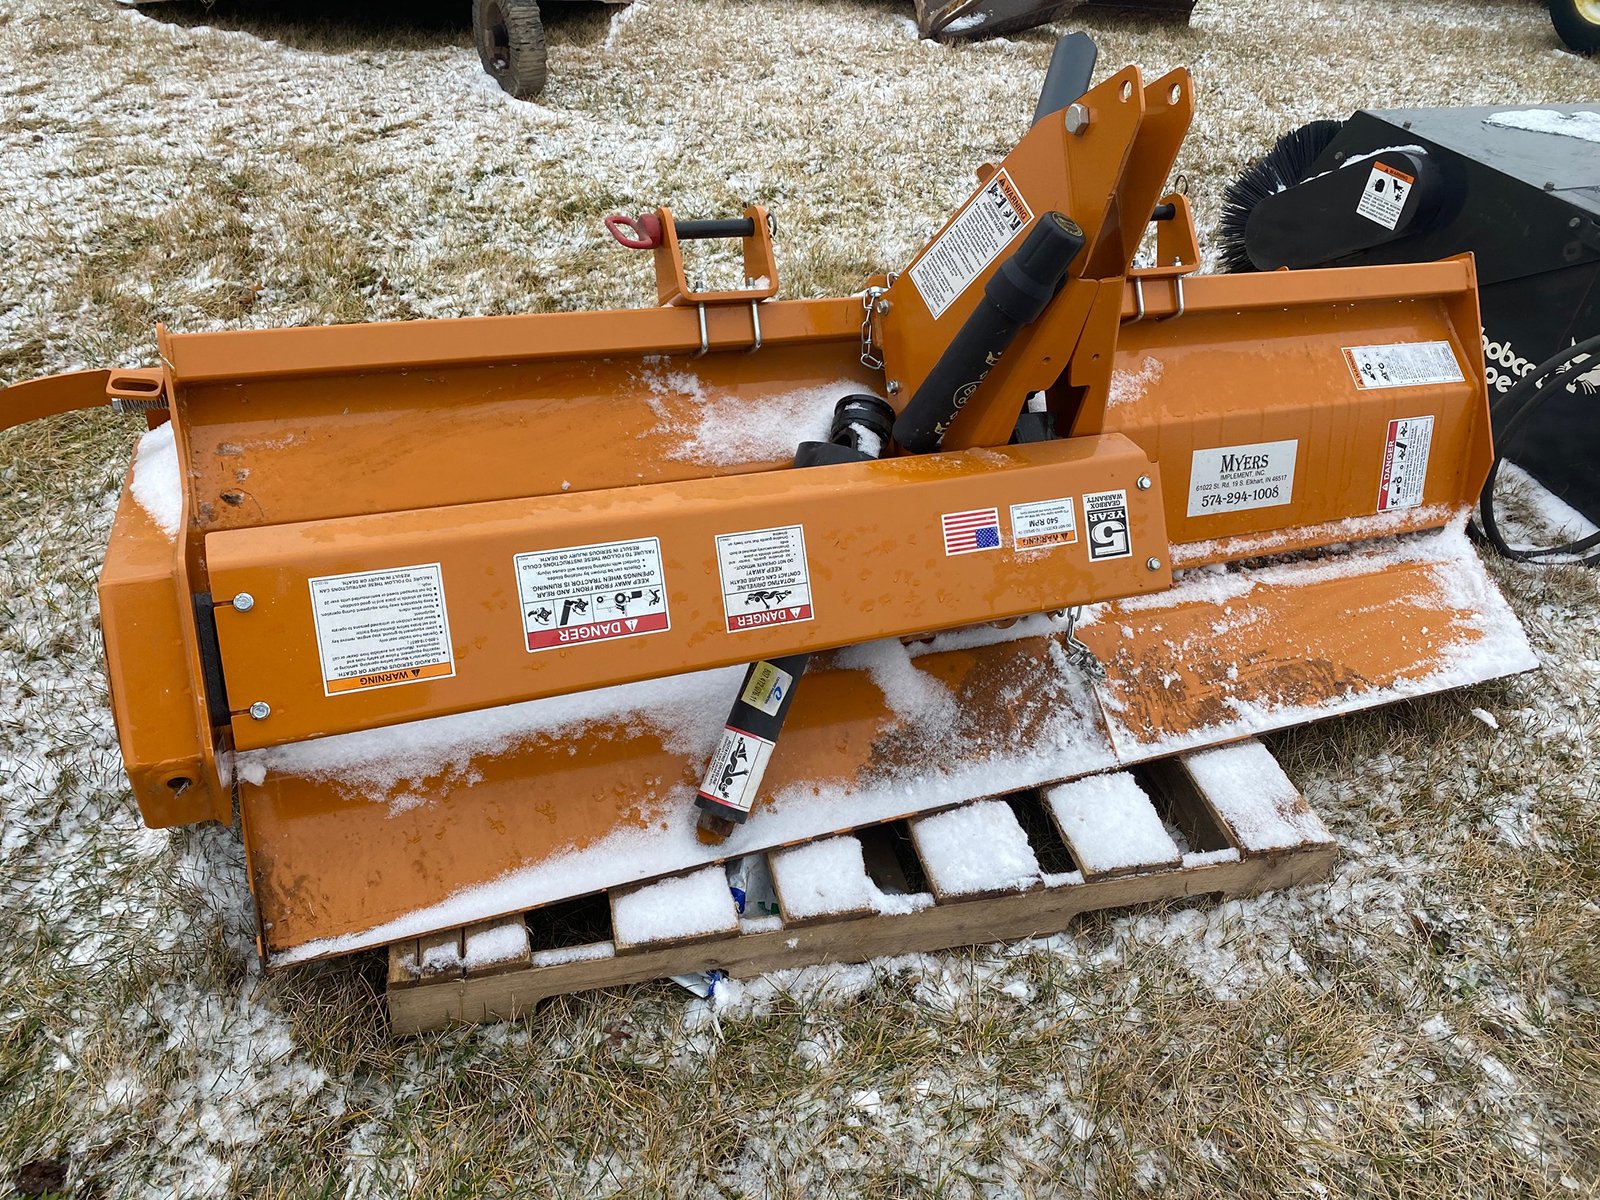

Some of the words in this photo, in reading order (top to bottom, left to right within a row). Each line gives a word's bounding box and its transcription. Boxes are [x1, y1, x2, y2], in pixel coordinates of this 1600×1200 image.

[1003, 184, 1027, 220] WARNING
[1345, 351, 1360, 377] WARNING
[1383, 440, 1394, 480] DANGER
[1220, 471, 1254, 480] IMPLEMENT,
[1195, 483, 1212, 492] 61022
[1086, 493, 1122, 503] WARRANTY
[1201, 485, 1279, 508] 574-294-1008
[1090, 499, 1120, 508] GEARBOX
[1046, 516, 1058, 524] 540
[1088, 509, 1124, 522] YEAR
[1028, 518, 1044, 527] RPM
[1090, 520, 1126, 556] 5
[588, 548, 611, 556] SERIOUS
[601, 552, 624, 560] FOLLOW
[633, 548, 654, 556] FAILURE
[542, 557, 582, 567] INSTRUCTIONS
[765, 565, 782, 573] KEEP
[602, 574, 622, 582] WHEN
[622, 569, 654, 579] OPENINGS
[777, 570, 800, 578] CONTACT
[571, 577, 601, 586] TRACTOR
[614, 579, 631, 587] AWAY
[631, 577, 649, 585] KEEP
[736, 581, 766, 590] DRIVELINE
[766, 576, 795, 586] ROTATING
[330, 583, 366, 592] INSTRUCTIONS
[572, 585, 593, 593] FRONT
[594, 582, 613, 590] FROM
[536, 590, 555, 598] REAR
[737, 609, 786, 626] DANGER
[558, 621, 621, 642] DANGER
[388, 661, 413, 669] SERIOUS
[359, 670, 408, 685] WARNING
